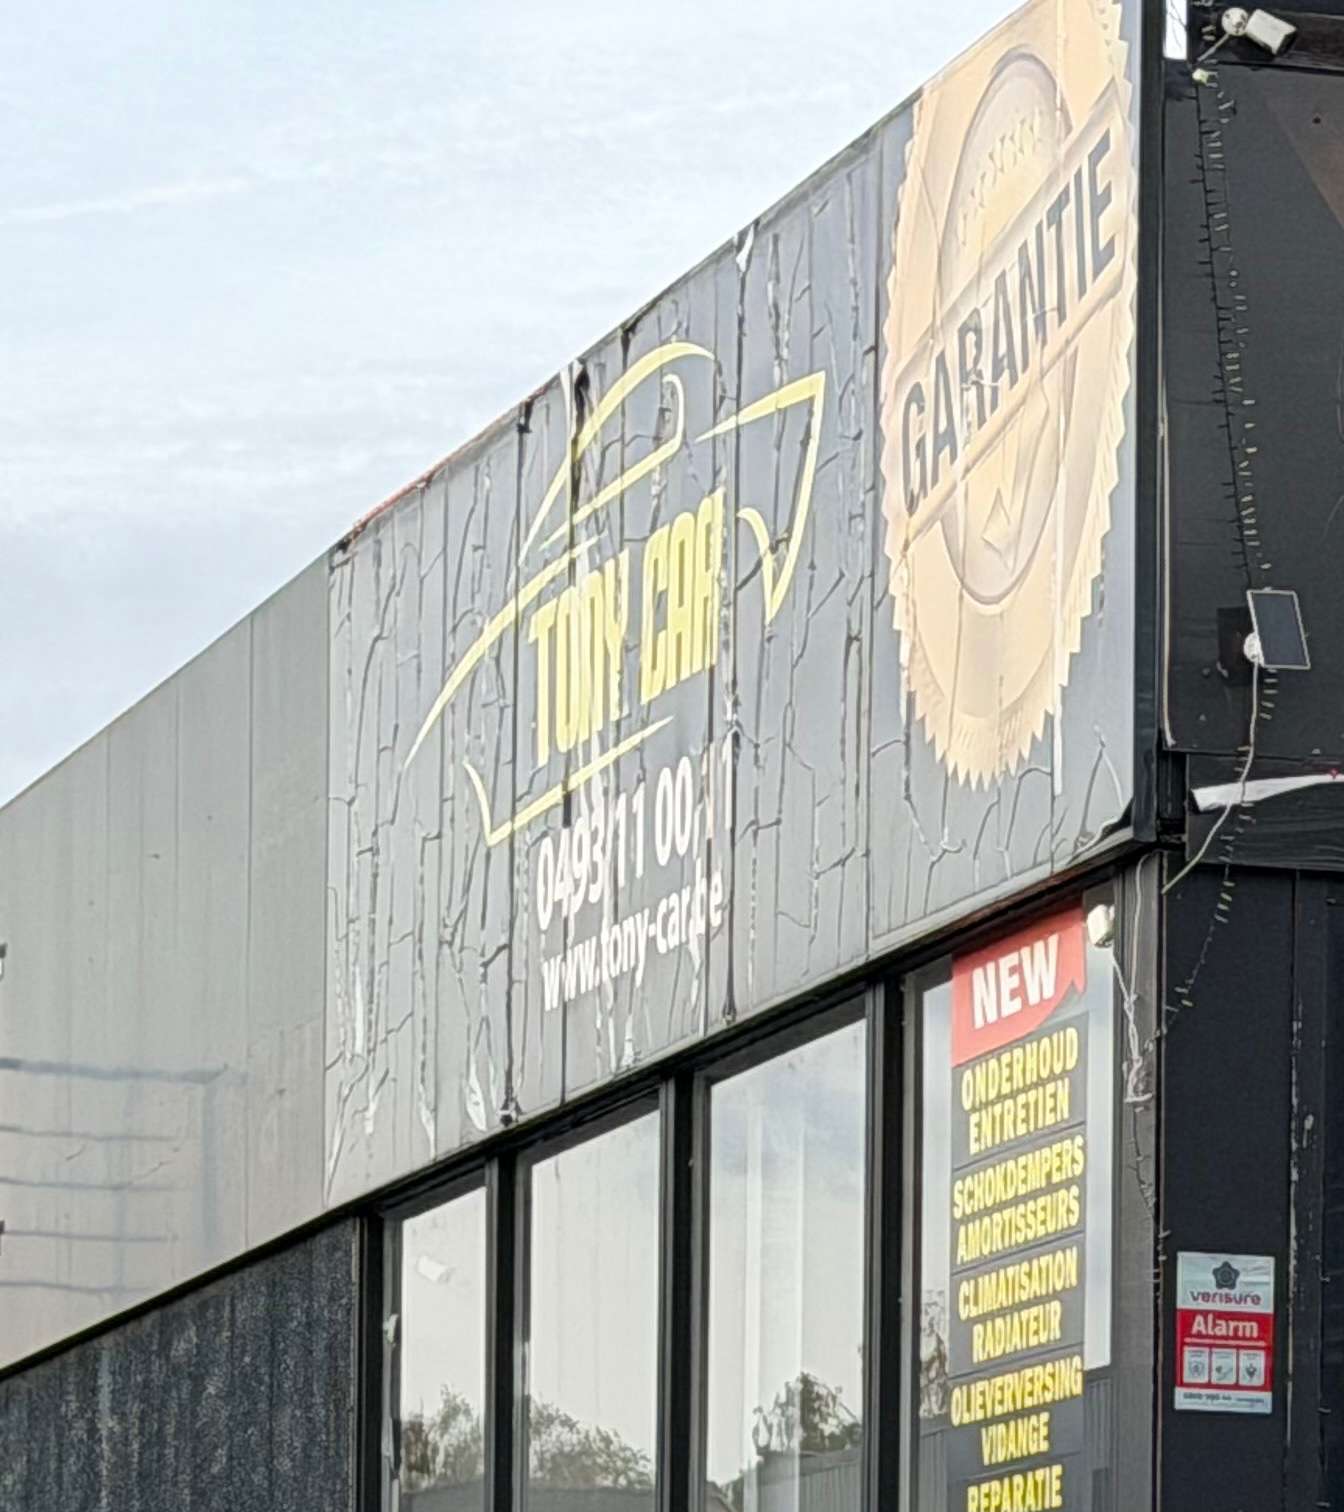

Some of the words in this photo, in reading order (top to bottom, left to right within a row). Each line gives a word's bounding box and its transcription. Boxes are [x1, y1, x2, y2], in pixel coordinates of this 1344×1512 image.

[902, 128, 1115, 517] GARANTIE
[528, 547, 631, 768] TONY
[641, 487, 726, 705] CAR
[655, 756, 694, 867] 00
[542, 857, 723, 1012] www.tony-car.be
[972, 934, 1060, 1030] NEW
[962, 1027, 1079, 1111] ONDERHOUD
[969, 1078, 1070, 1155] ENTRETIEN
[953, 1135, 1085, 1219] SCHOKDEMPERS
[957, 1187, 1079, 1265] AMORTISSEURS
[958, 1246, 1078, 1321] CLIMATISATION
[1189, 1290, 1262, 1306] verisure
[972, 1300, 1062, 1364] RADIATEUR
[1191, 1314, 1259, 1339] Alarm
[950, 1354, 1083, 1427] OLIEVERVERSING
[981, 1411, 1050, 1466] VIDANGE
